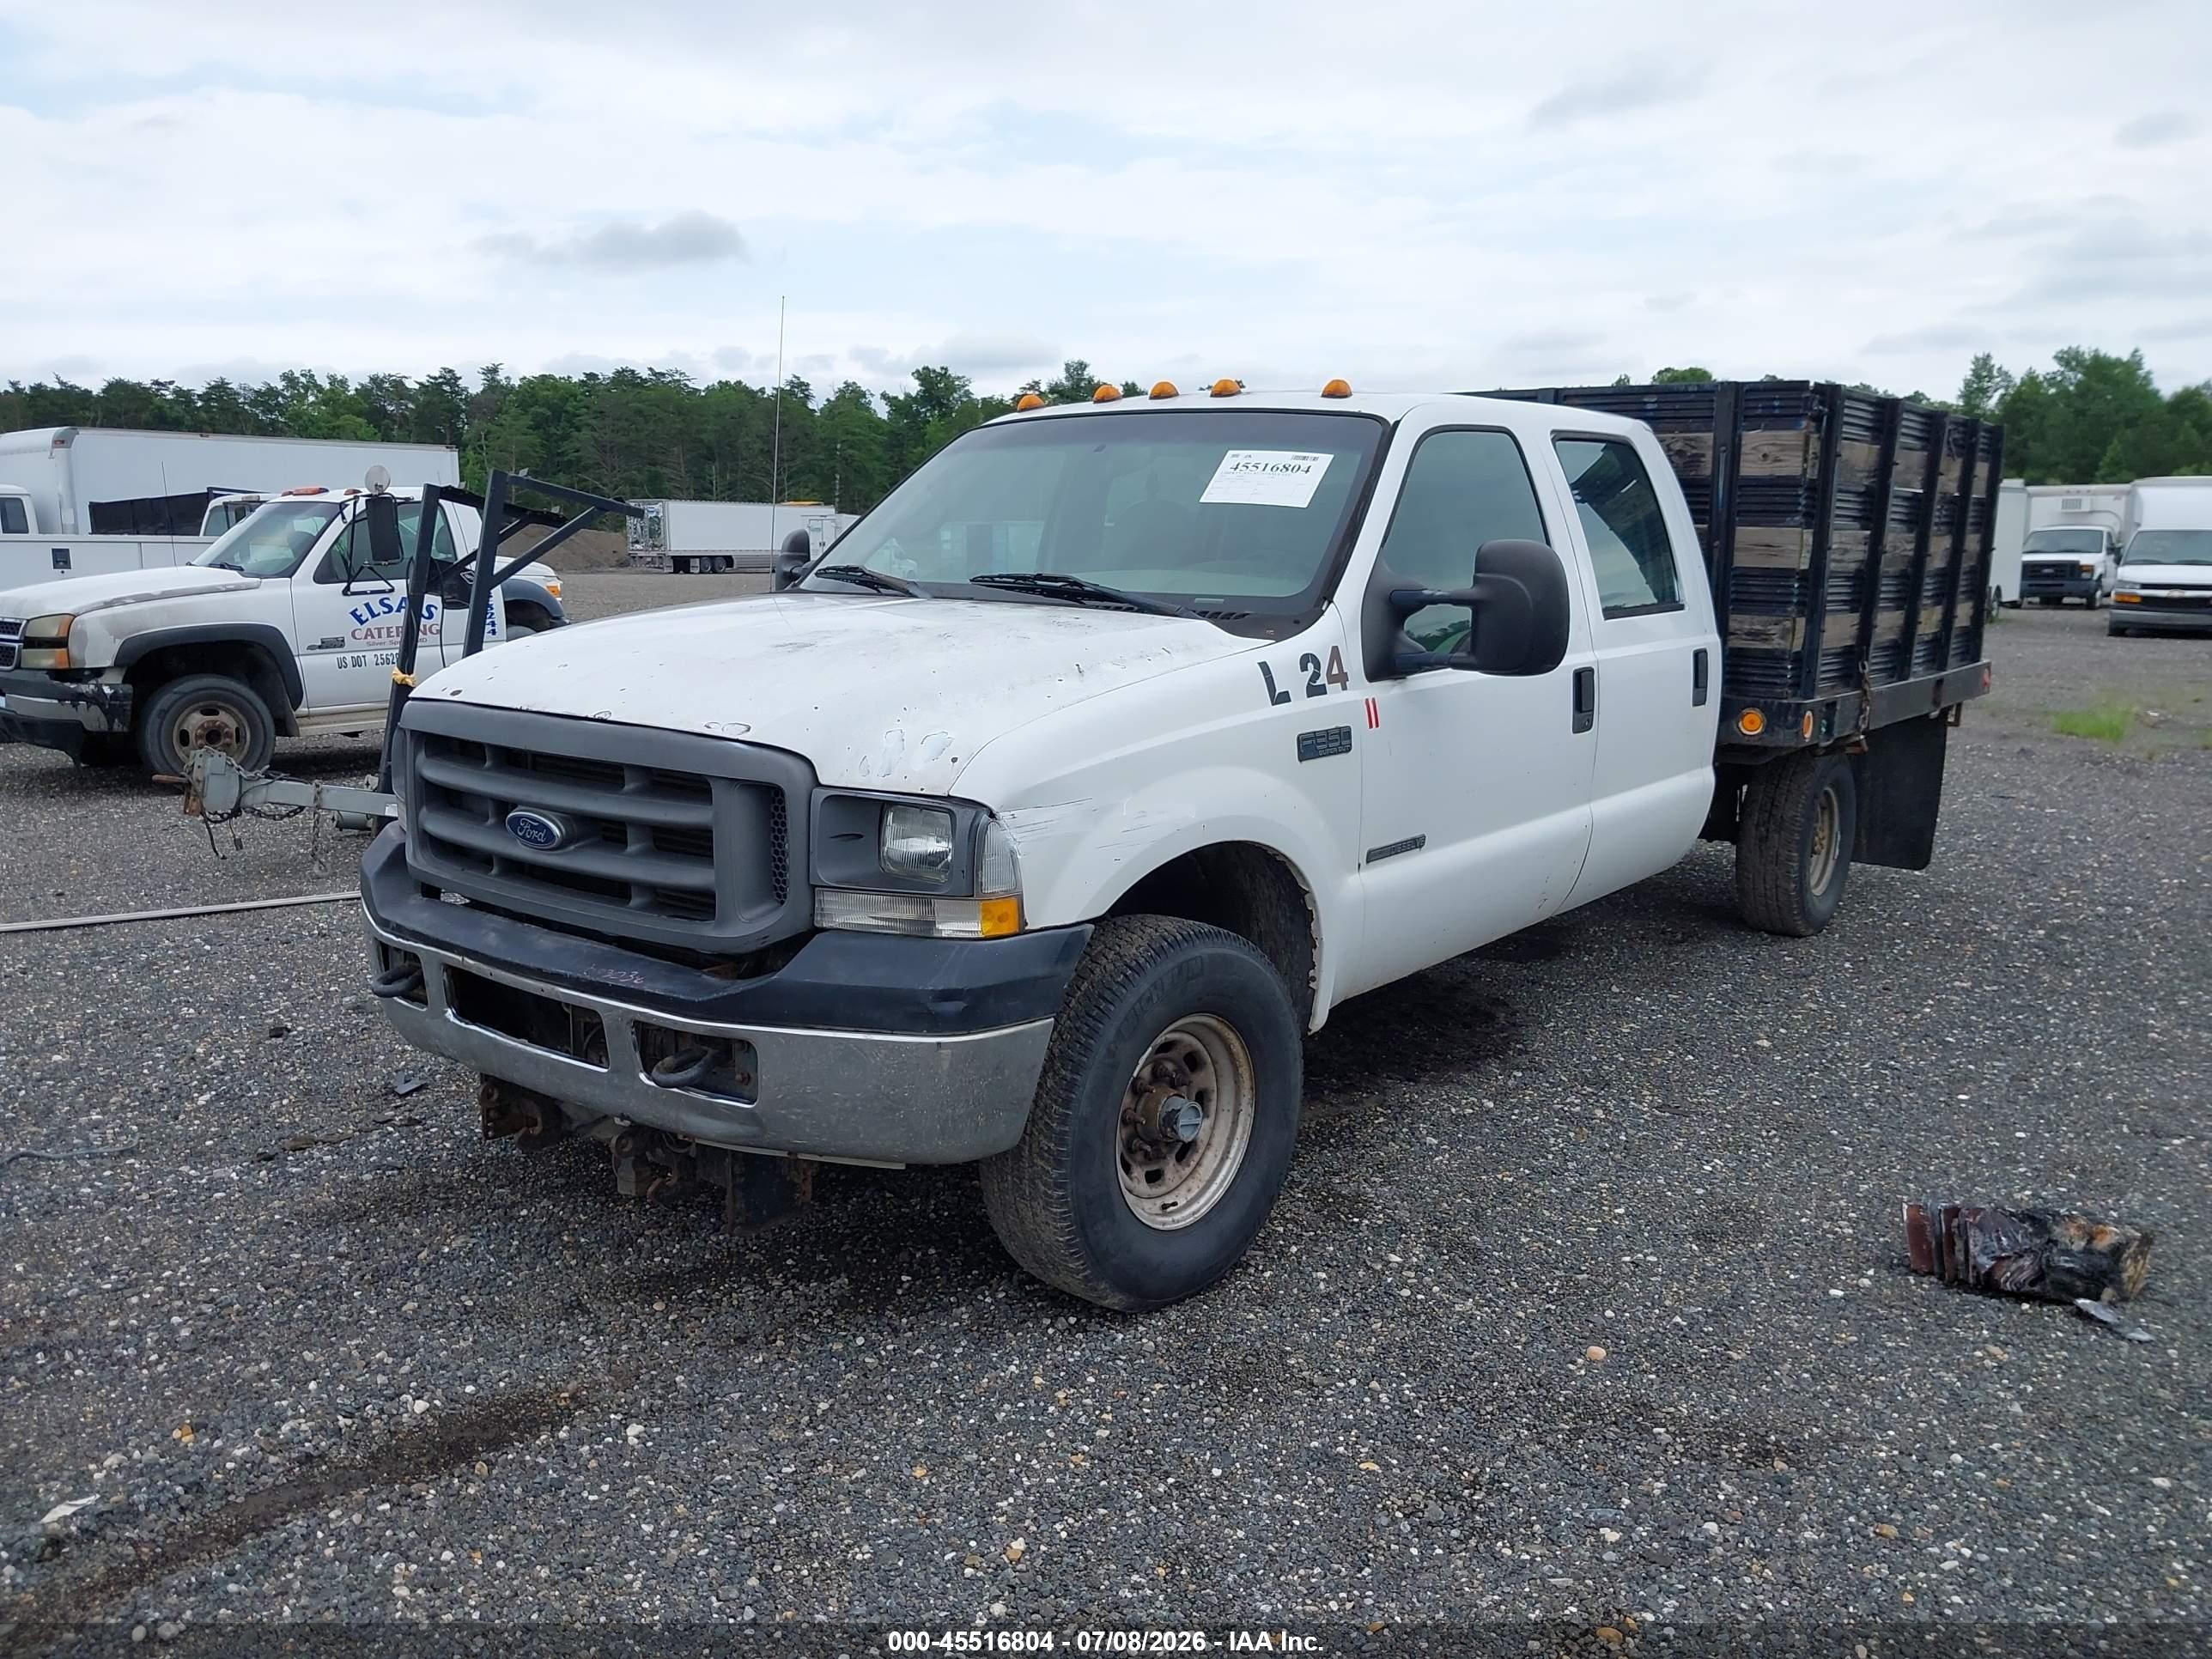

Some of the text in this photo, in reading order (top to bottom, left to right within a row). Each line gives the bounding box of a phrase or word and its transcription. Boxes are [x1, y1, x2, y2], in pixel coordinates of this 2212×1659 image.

[1230, 462, 1312, 475] 45516804
[349, 596, 438, 626] ELSAS
[350, 624, 440, 641] CATERNG
[337, 656, 348, 669] US
[350, 654, 367, 668] DOT
[1299, 646, 1349, 698] 24
[517, 818, 546, 842] Ford
